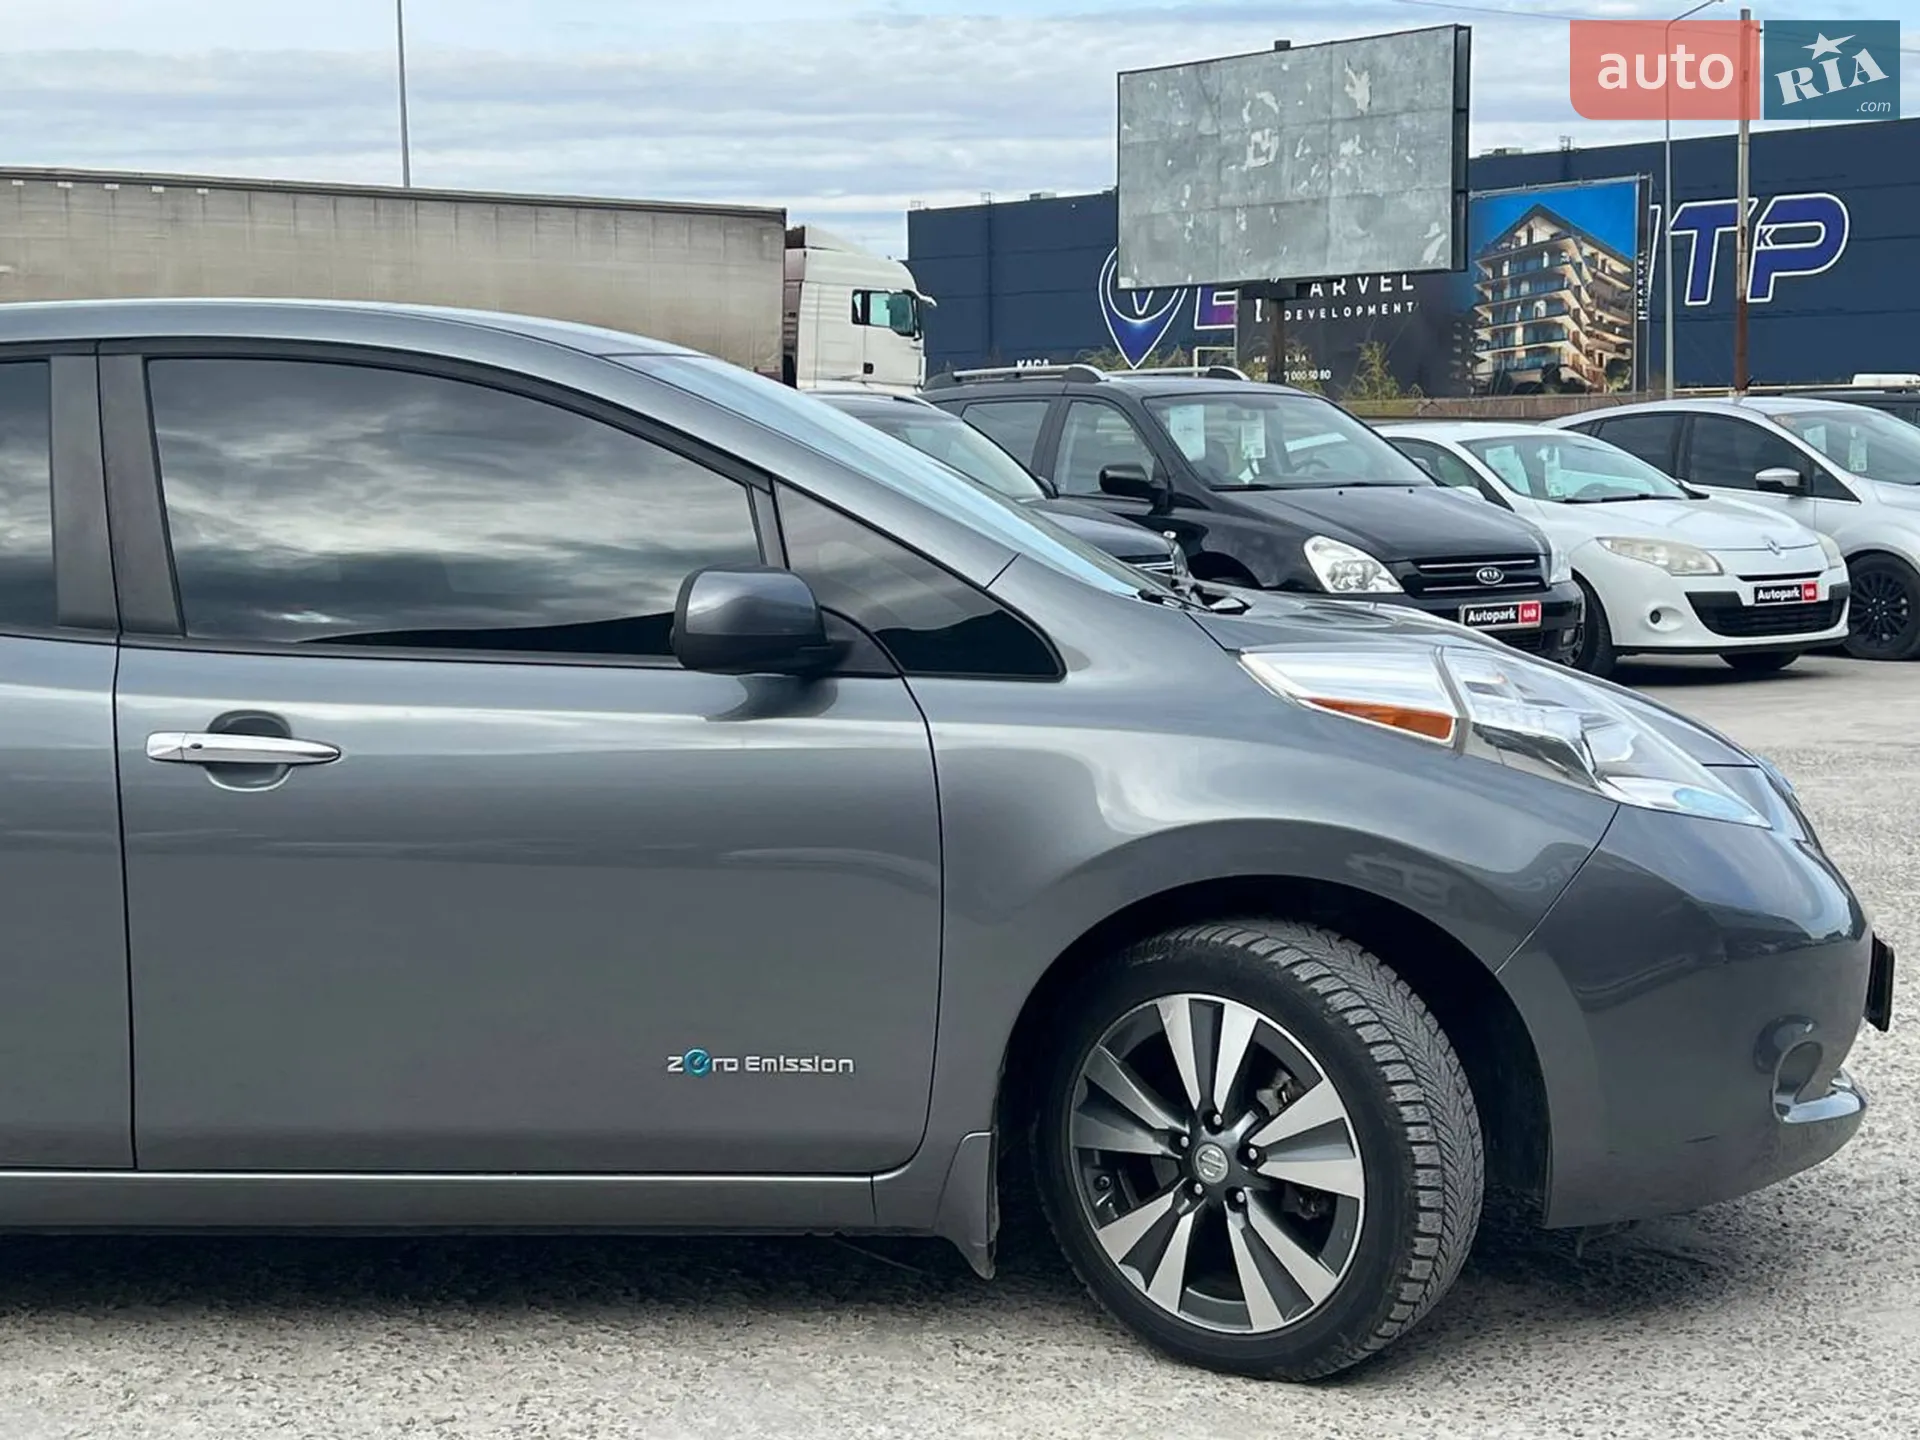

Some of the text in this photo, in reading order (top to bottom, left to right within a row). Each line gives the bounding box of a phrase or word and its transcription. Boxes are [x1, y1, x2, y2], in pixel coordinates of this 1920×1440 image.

[1284, 302, 1413, 321] DEVELOPMENT
[1481, 571, 1500, 580] KIA
[1757, 587, 1800, 601] Autopark
[1467, 607, 1536, 623] Autopark ua
[745, 1055, 854, 1073] Emission
